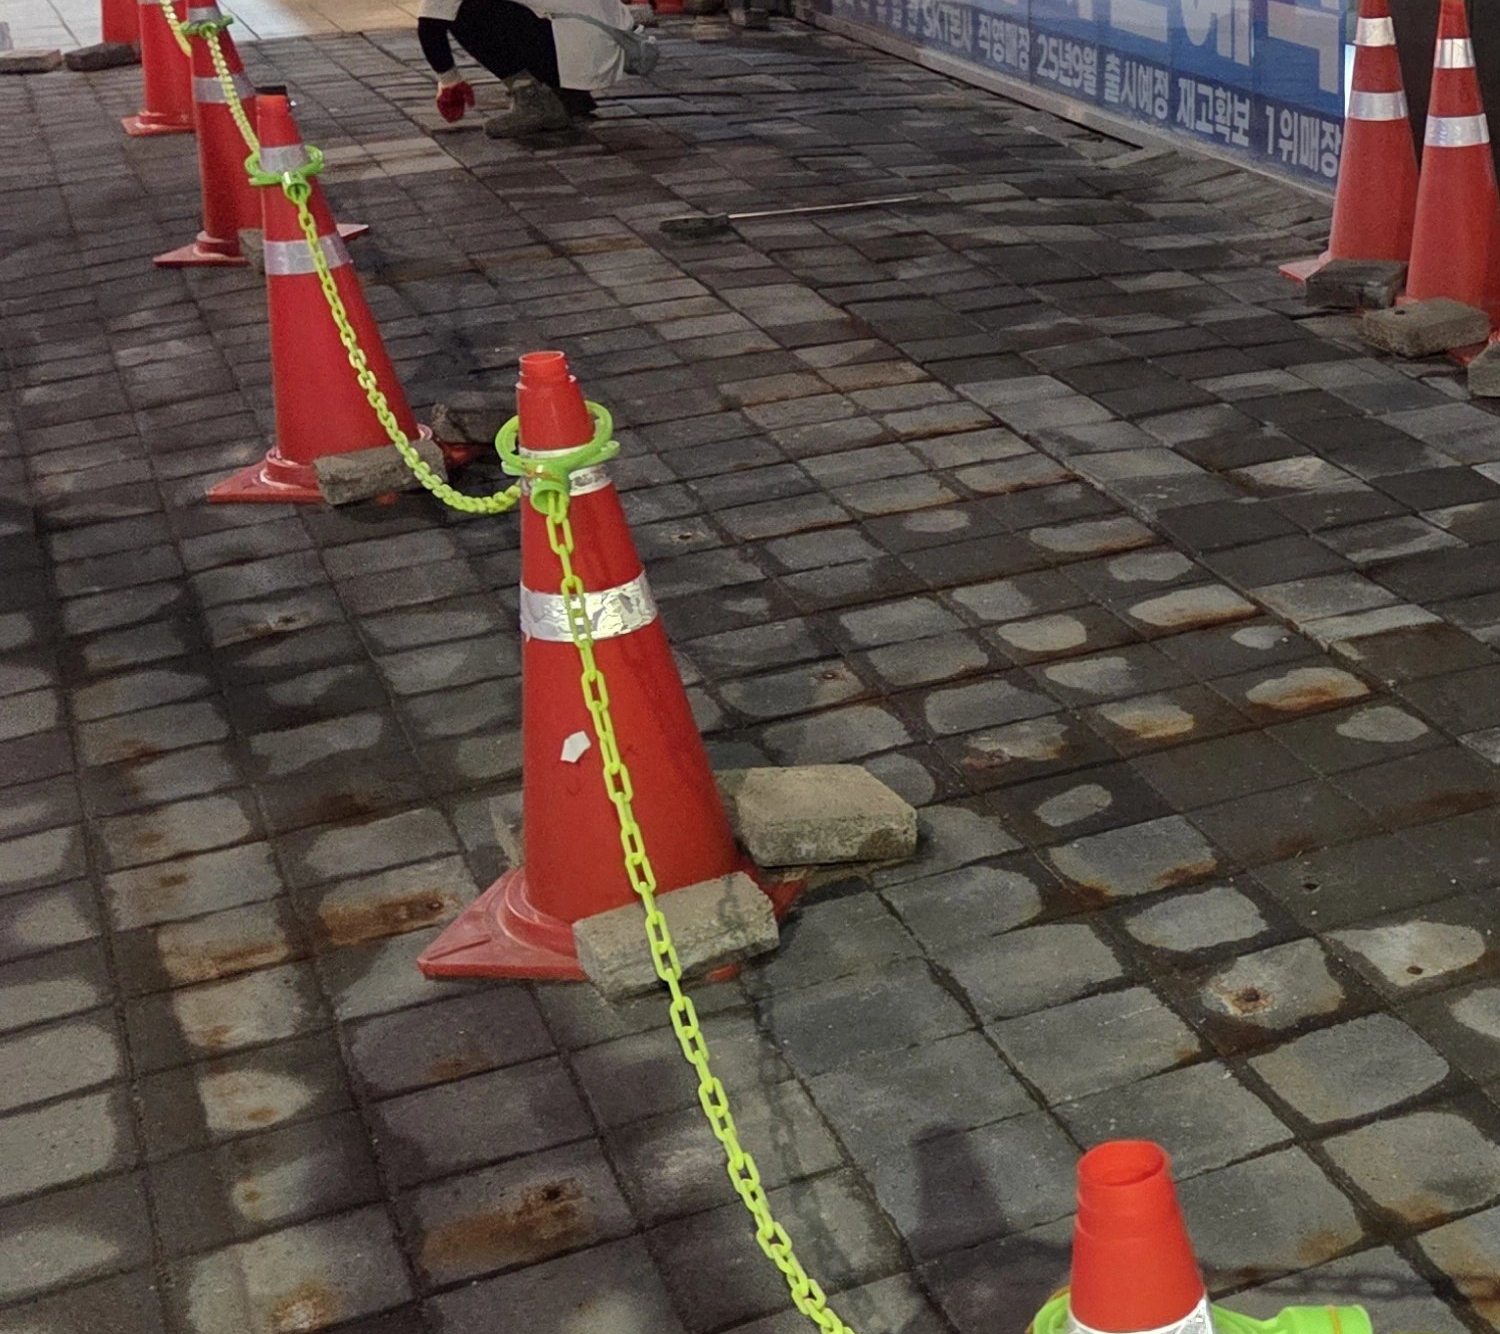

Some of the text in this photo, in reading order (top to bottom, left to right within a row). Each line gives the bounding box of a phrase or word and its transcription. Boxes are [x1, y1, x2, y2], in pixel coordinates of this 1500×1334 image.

[1037, 34, 1098, 95] 25년9월
[1104, 53, 1169, 120] 출시예정
[1176, 77, 1249, 147] 재고확보
